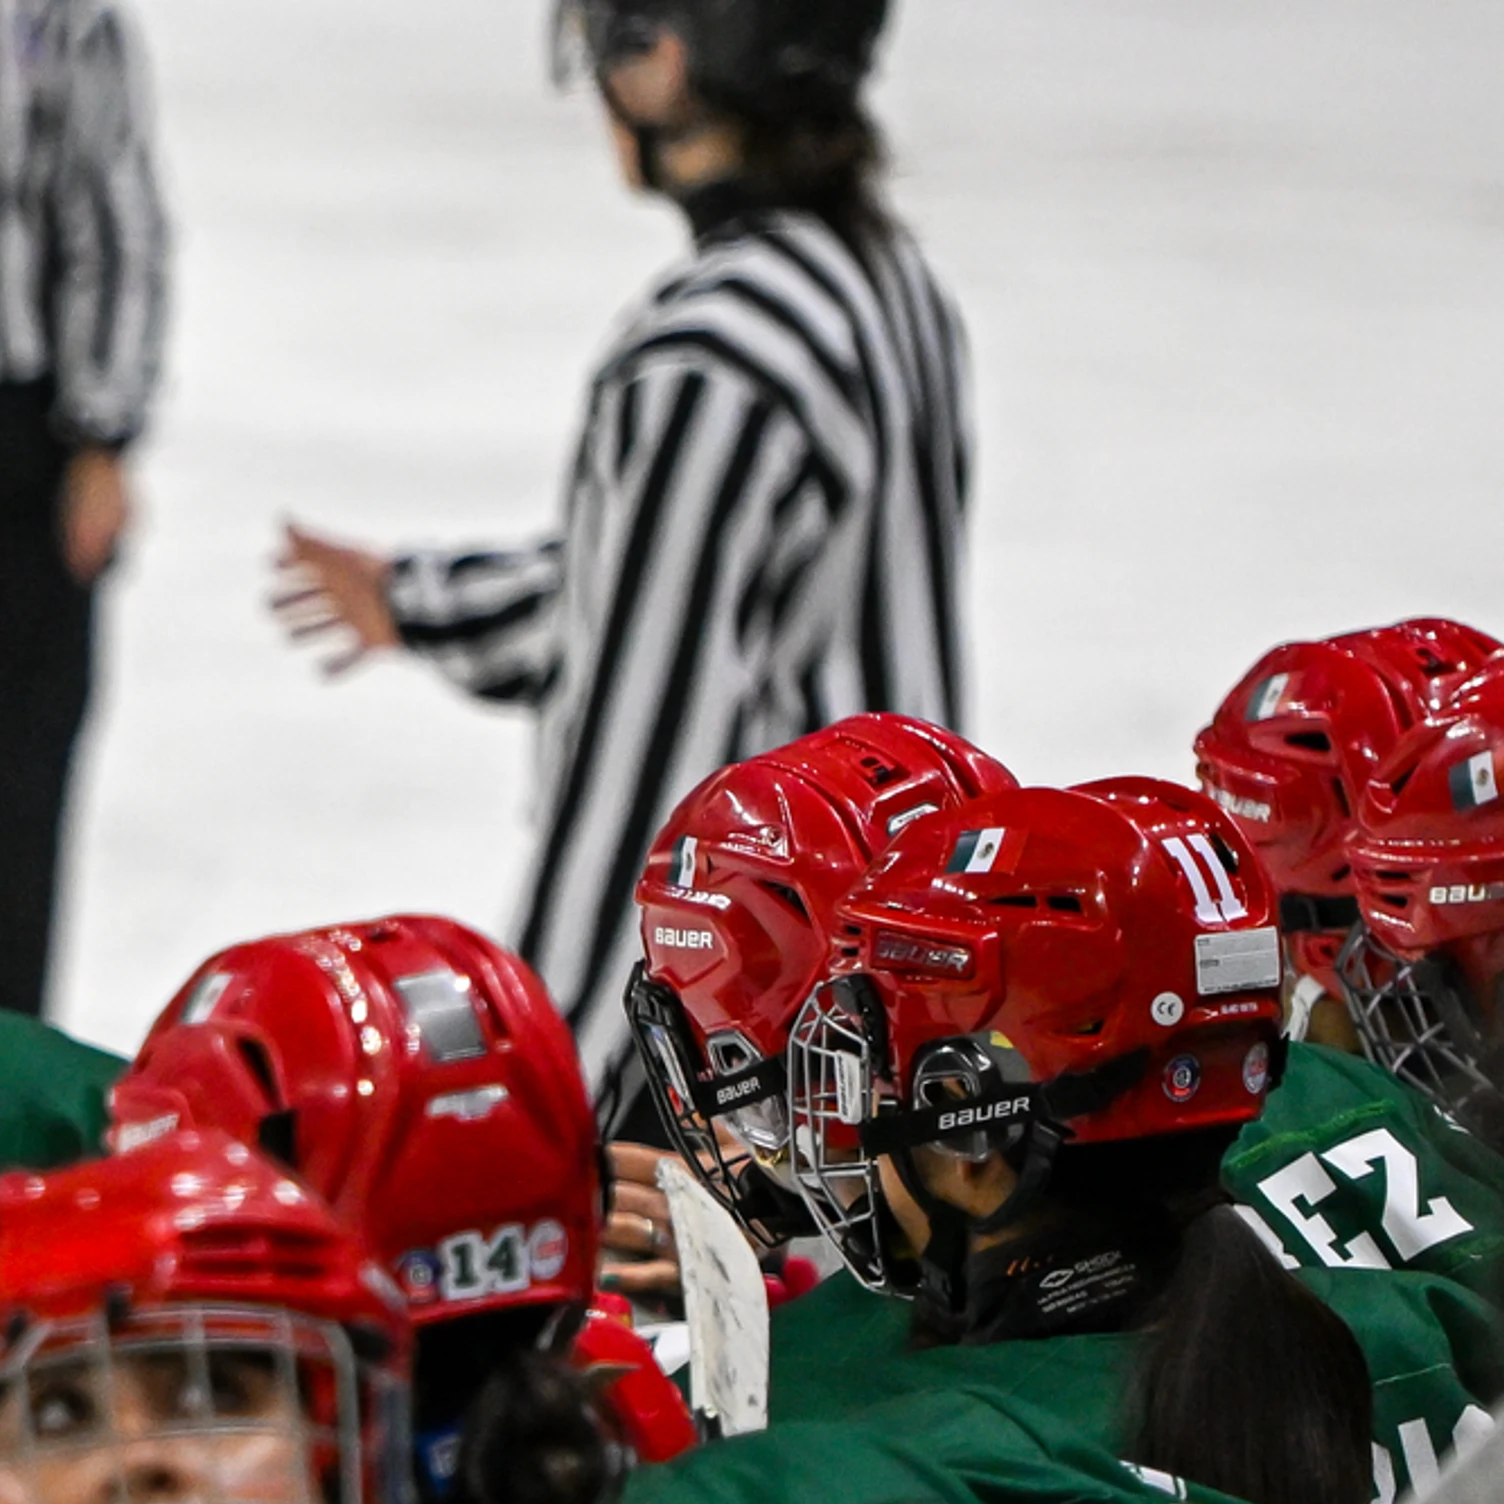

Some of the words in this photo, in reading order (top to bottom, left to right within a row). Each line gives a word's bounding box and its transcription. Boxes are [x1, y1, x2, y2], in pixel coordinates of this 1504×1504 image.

[1160, 833, 1249, 923] 11
[1429, 883, 1491, 905] BAU
[654, 926, 714, 949] BAUER
[715, 1076, 762, 1104] BAUER
[937, 1096, 1031, 1131] BAUER
[1234, 1128, 1475, 1271] EZ
[448, 1232, 524, 1292] 14
